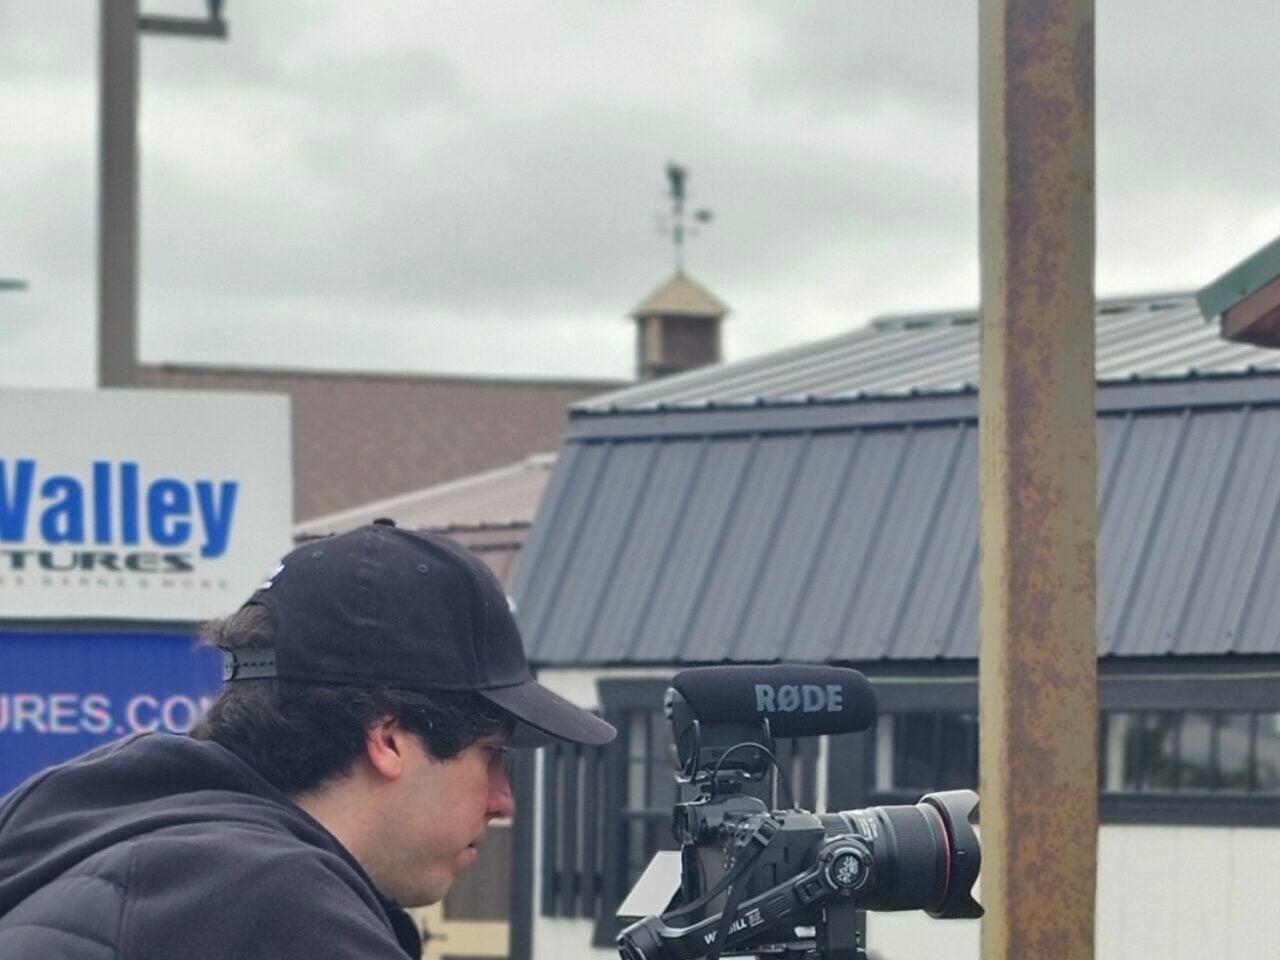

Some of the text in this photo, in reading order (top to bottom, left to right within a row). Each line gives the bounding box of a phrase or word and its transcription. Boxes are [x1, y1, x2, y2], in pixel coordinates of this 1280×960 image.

[0, 459, 239, 558] Valley
[0, 694, 209, 734] RES.CO
[755, 684, 843, 712] RØDE
